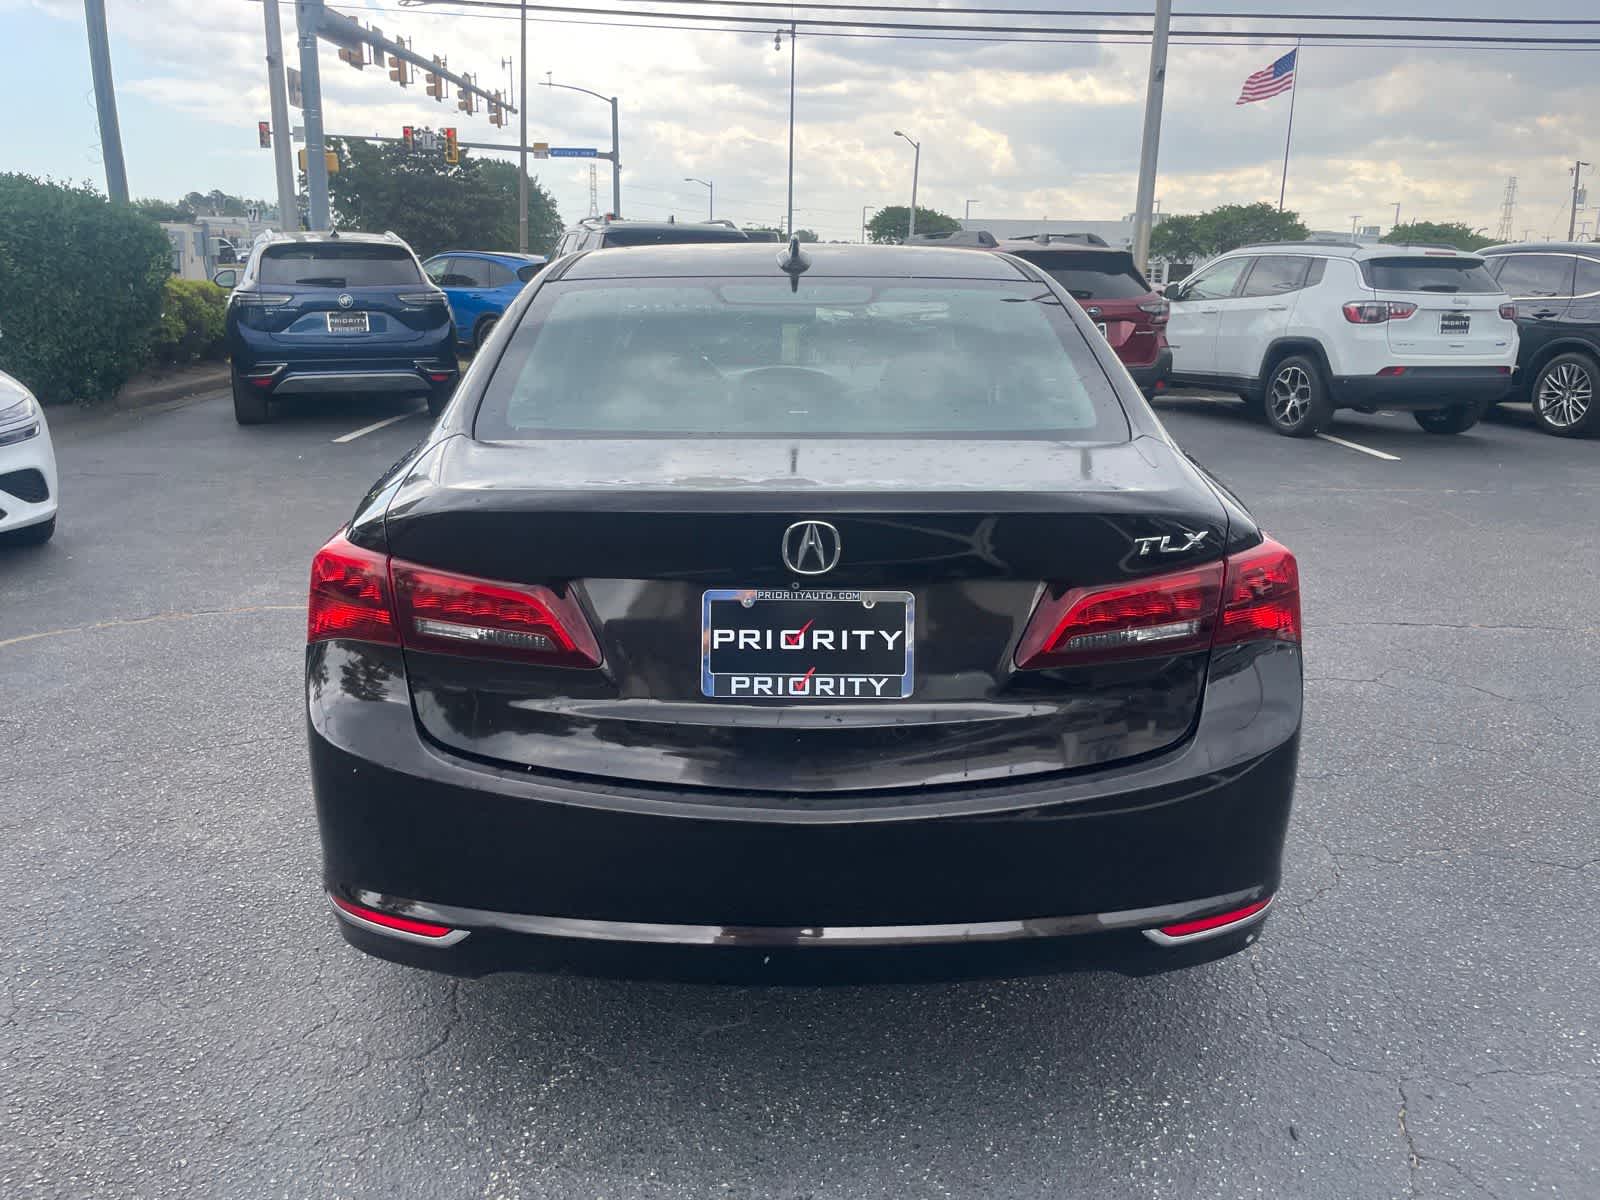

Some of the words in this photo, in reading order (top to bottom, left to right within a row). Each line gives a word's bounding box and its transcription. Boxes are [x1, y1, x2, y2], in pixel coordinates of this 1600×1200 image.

[1134, 530, 1209, 555] TLX
[757, 590, 861, 600] PRIORITYAUTO.COM
[713, 629, 903, 650] PRIORITY
[731, 676, 889, 696] PRIORITY
